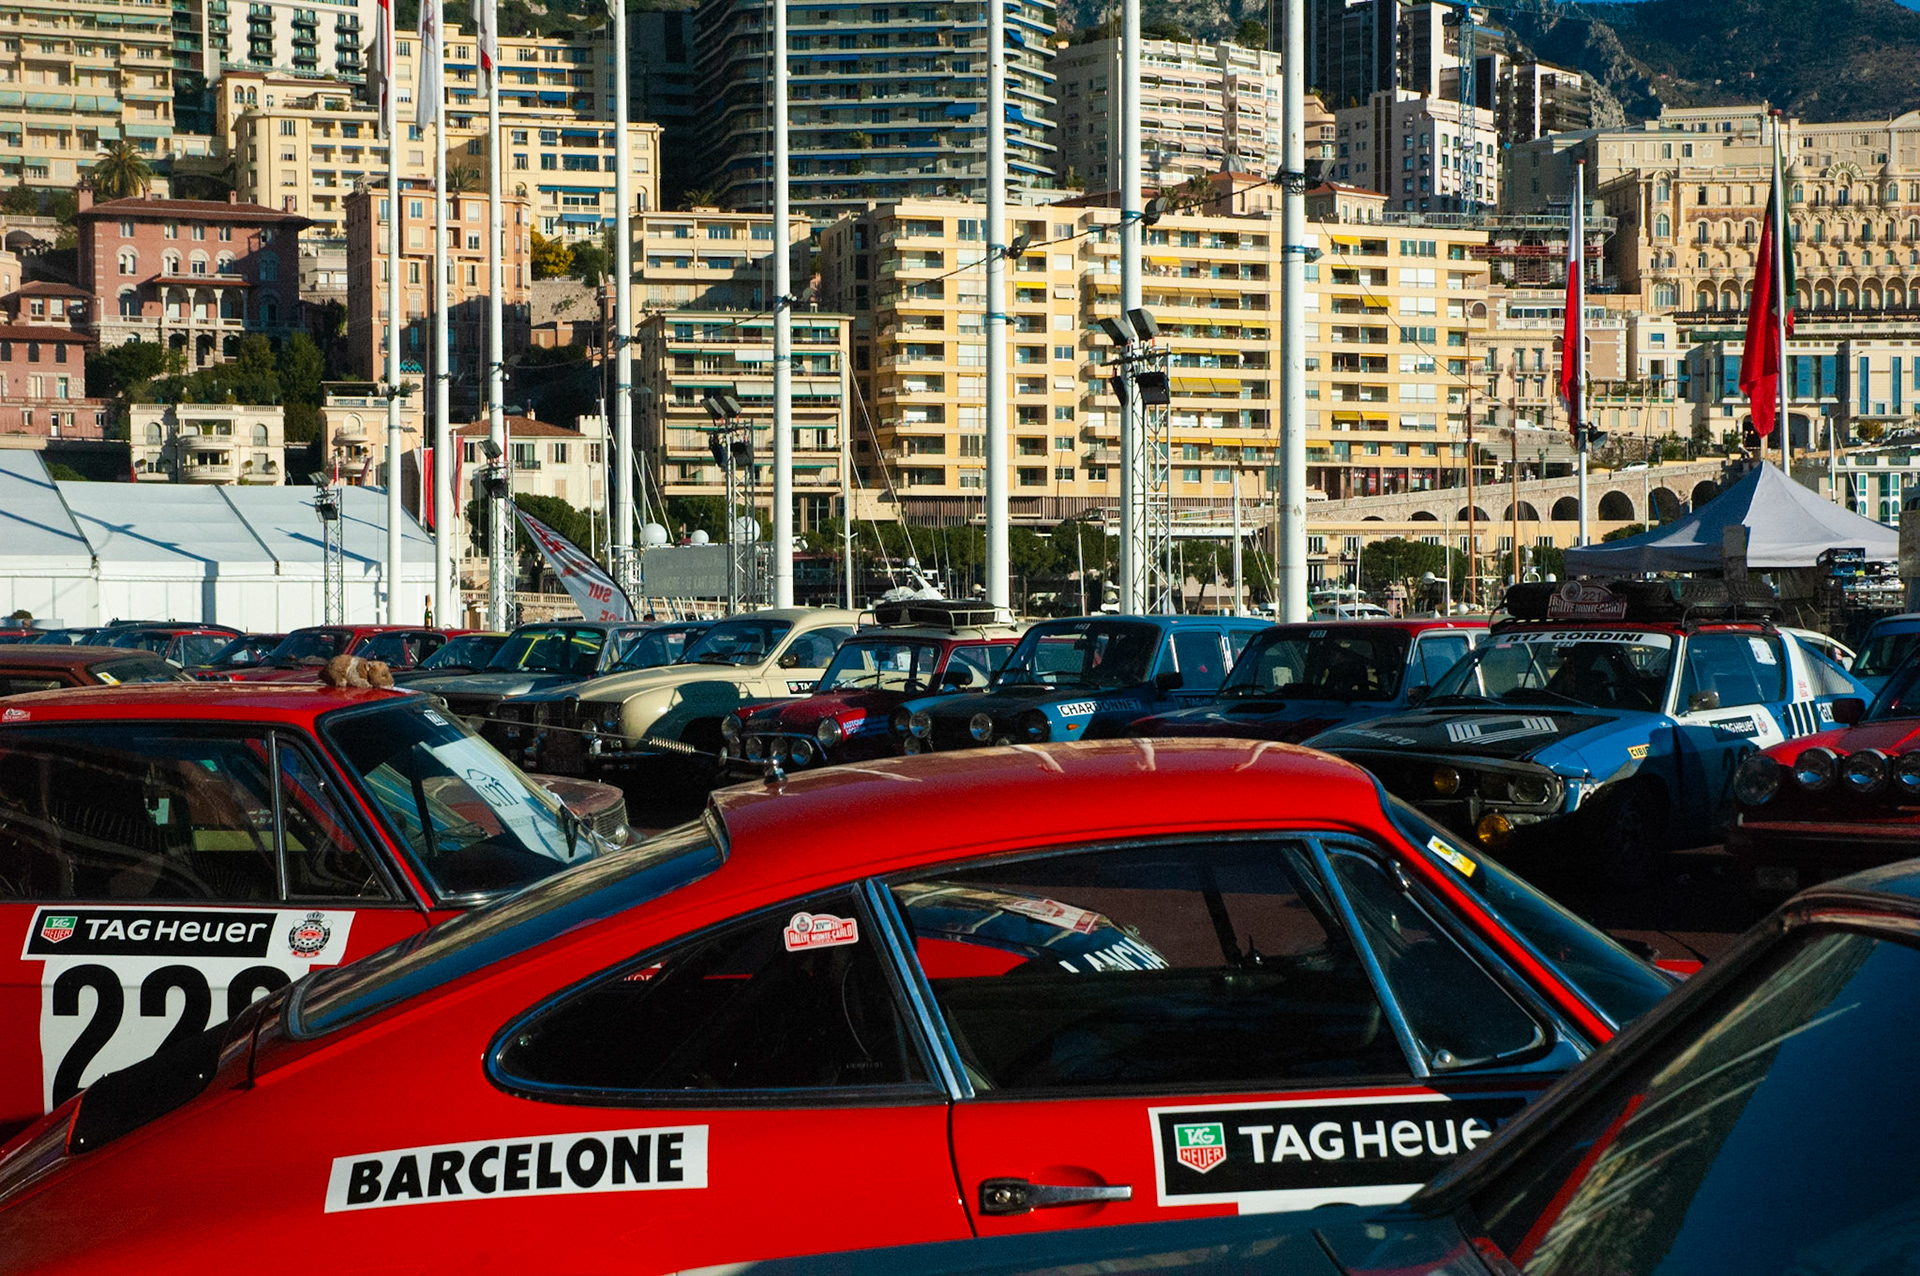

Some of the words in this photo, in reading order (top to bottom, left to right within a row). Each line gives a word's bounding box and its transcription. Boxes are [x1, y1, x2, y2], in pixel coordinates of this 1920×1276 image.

[1506, 633, 1544, 643] R17
[1551, 633, 1644, 642] GORDINI
[1060, 700, 1140, 717] CHARDONNET
[1185, 1127, 1216, 1145] TAG
[1238, 1117, 1508, 1164] TAGHeue
[1182, 1147, 1223, 1166] HEUER
[346, 1132, 685, 1205] BARCELONE
